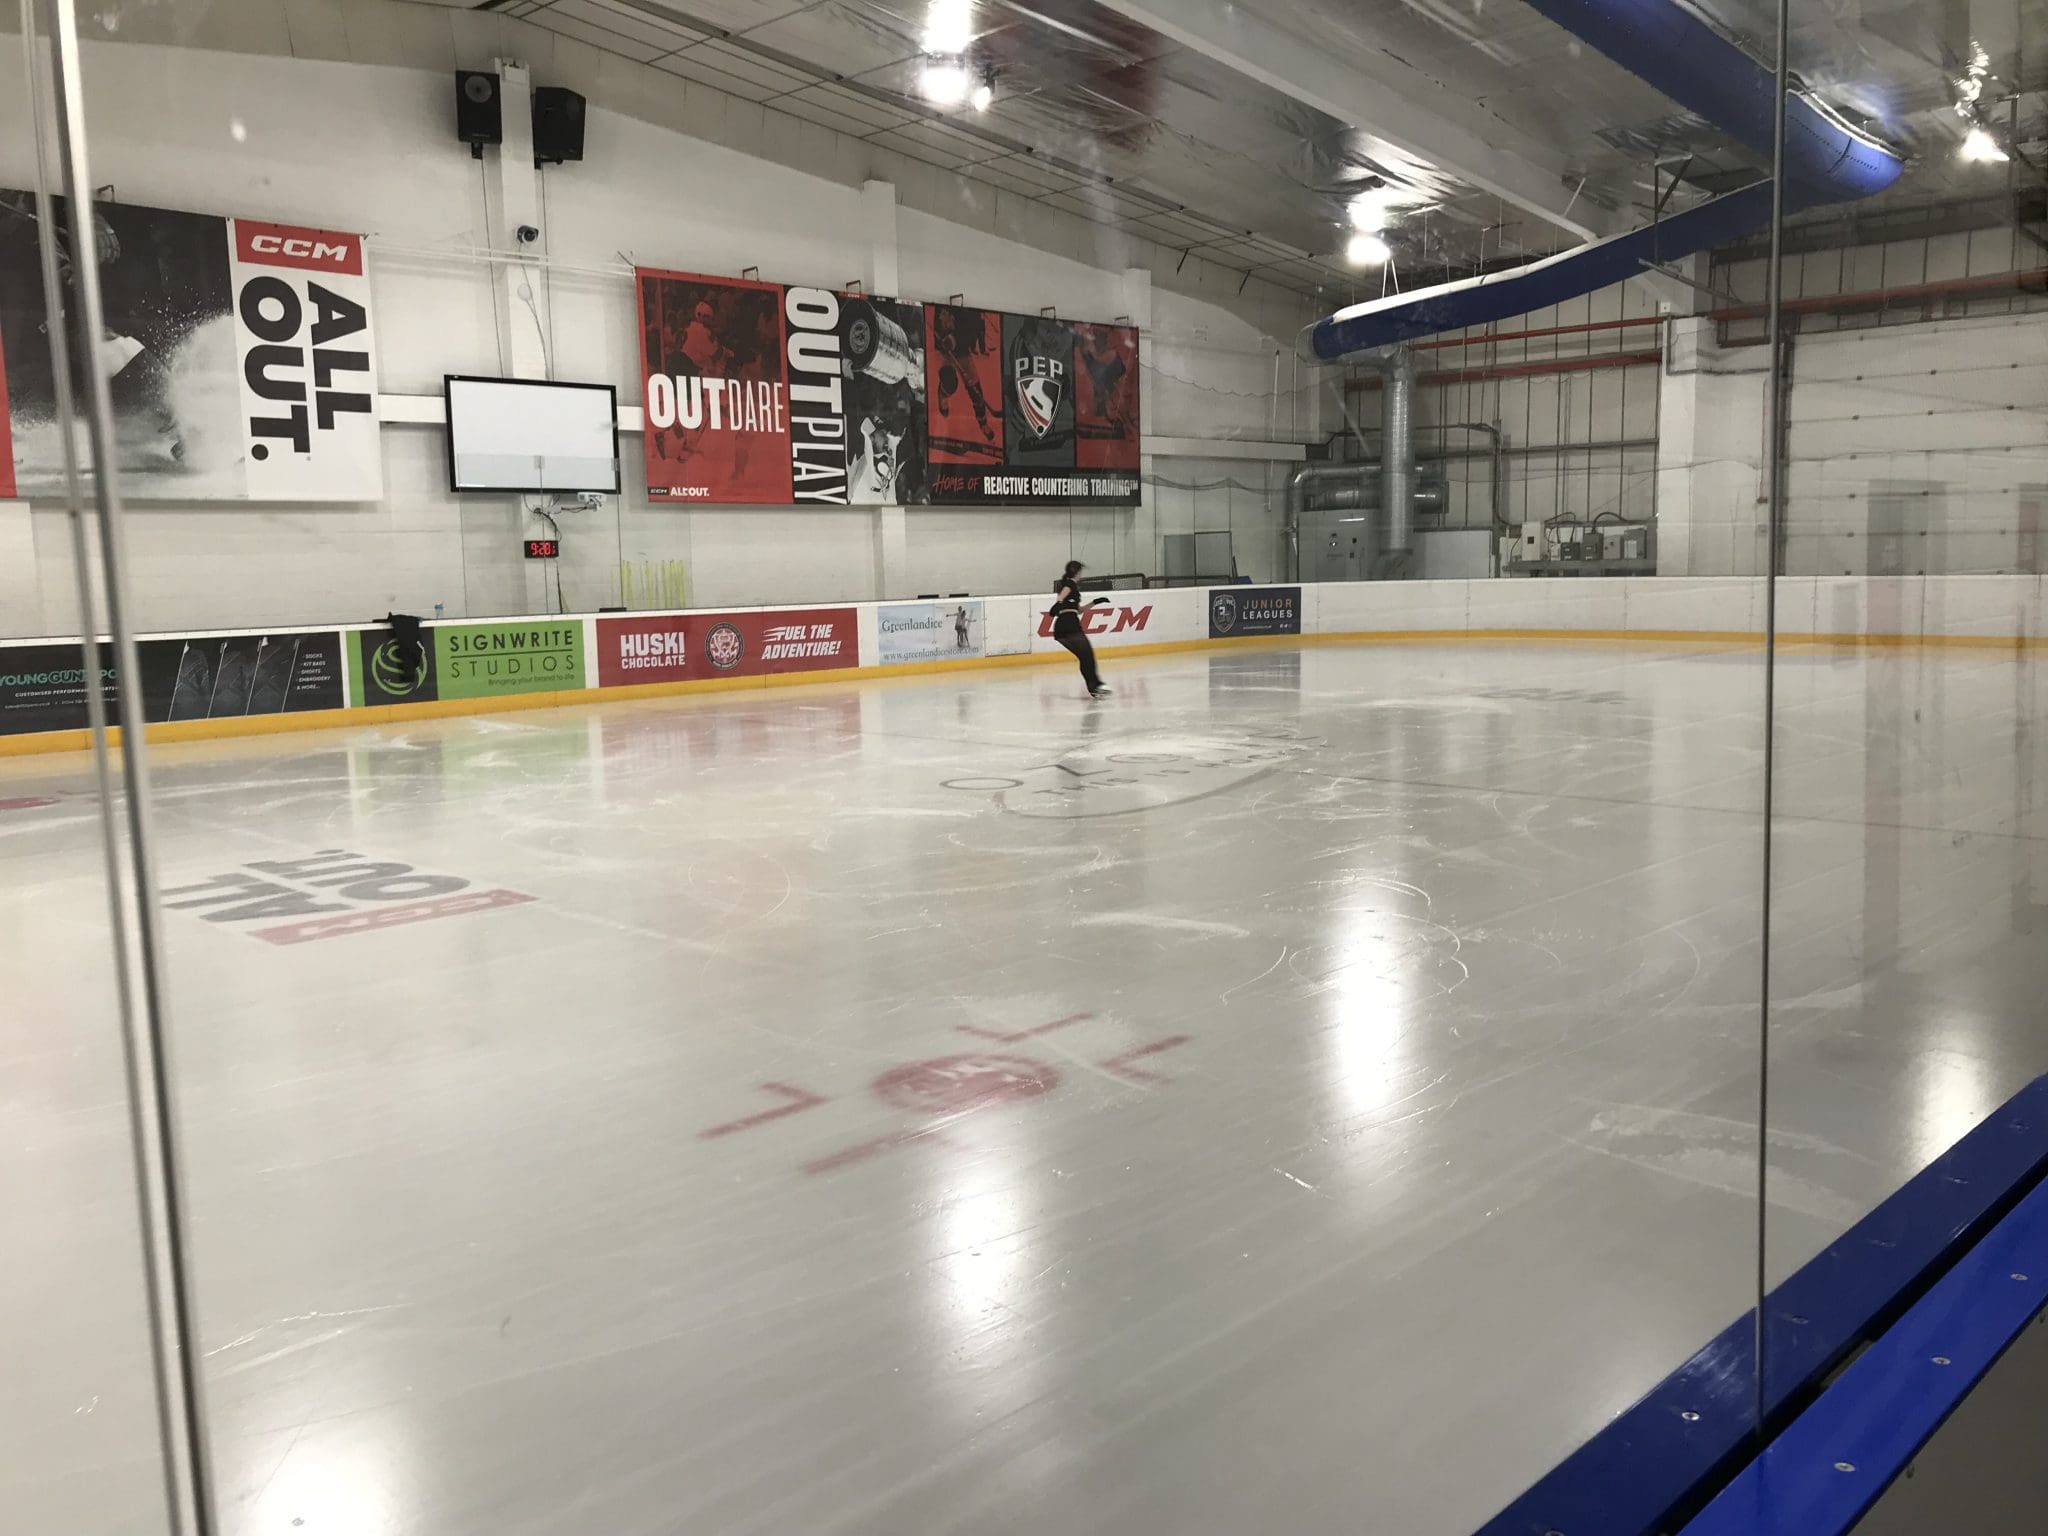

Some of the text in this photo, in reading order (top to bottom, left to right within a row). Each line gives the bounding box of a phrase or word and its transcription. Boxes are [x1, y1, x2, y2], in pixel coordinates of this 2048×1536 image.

[251, 234, 348, 262] CCM
[307, 279, 372, 430] ALL
[239, 275, 311, 461] OUT.
[1015, 355, 1064, 379] PEP
[647, 373, 786, 434] OUTDARE
[785, 286, 849, 505] OUTPLAY
[932, 473, 964, 495] HOME
[967, 477, 981, 492] OF
[983, 475, 1031, 496] REACTIVE
[1031, 476, 1089, 497] COUNTERING
[1242, 609, 1294, 620] LEAGUES
[1243, 598, 1293, 610] JUNIOR
[763, 623, 834, 642] FUEL THE
[881, 617, 943, 634] Greenlandice
[449, 630, 574, 653] SIGNWRITE
[620, 631, 685, 658] HUSKI
[761, 640, 842, 661] ADVENTURE!
[450, 654, 575, 679] STUDIOS
[621, 654, 686, 670] CHOCOLATE
